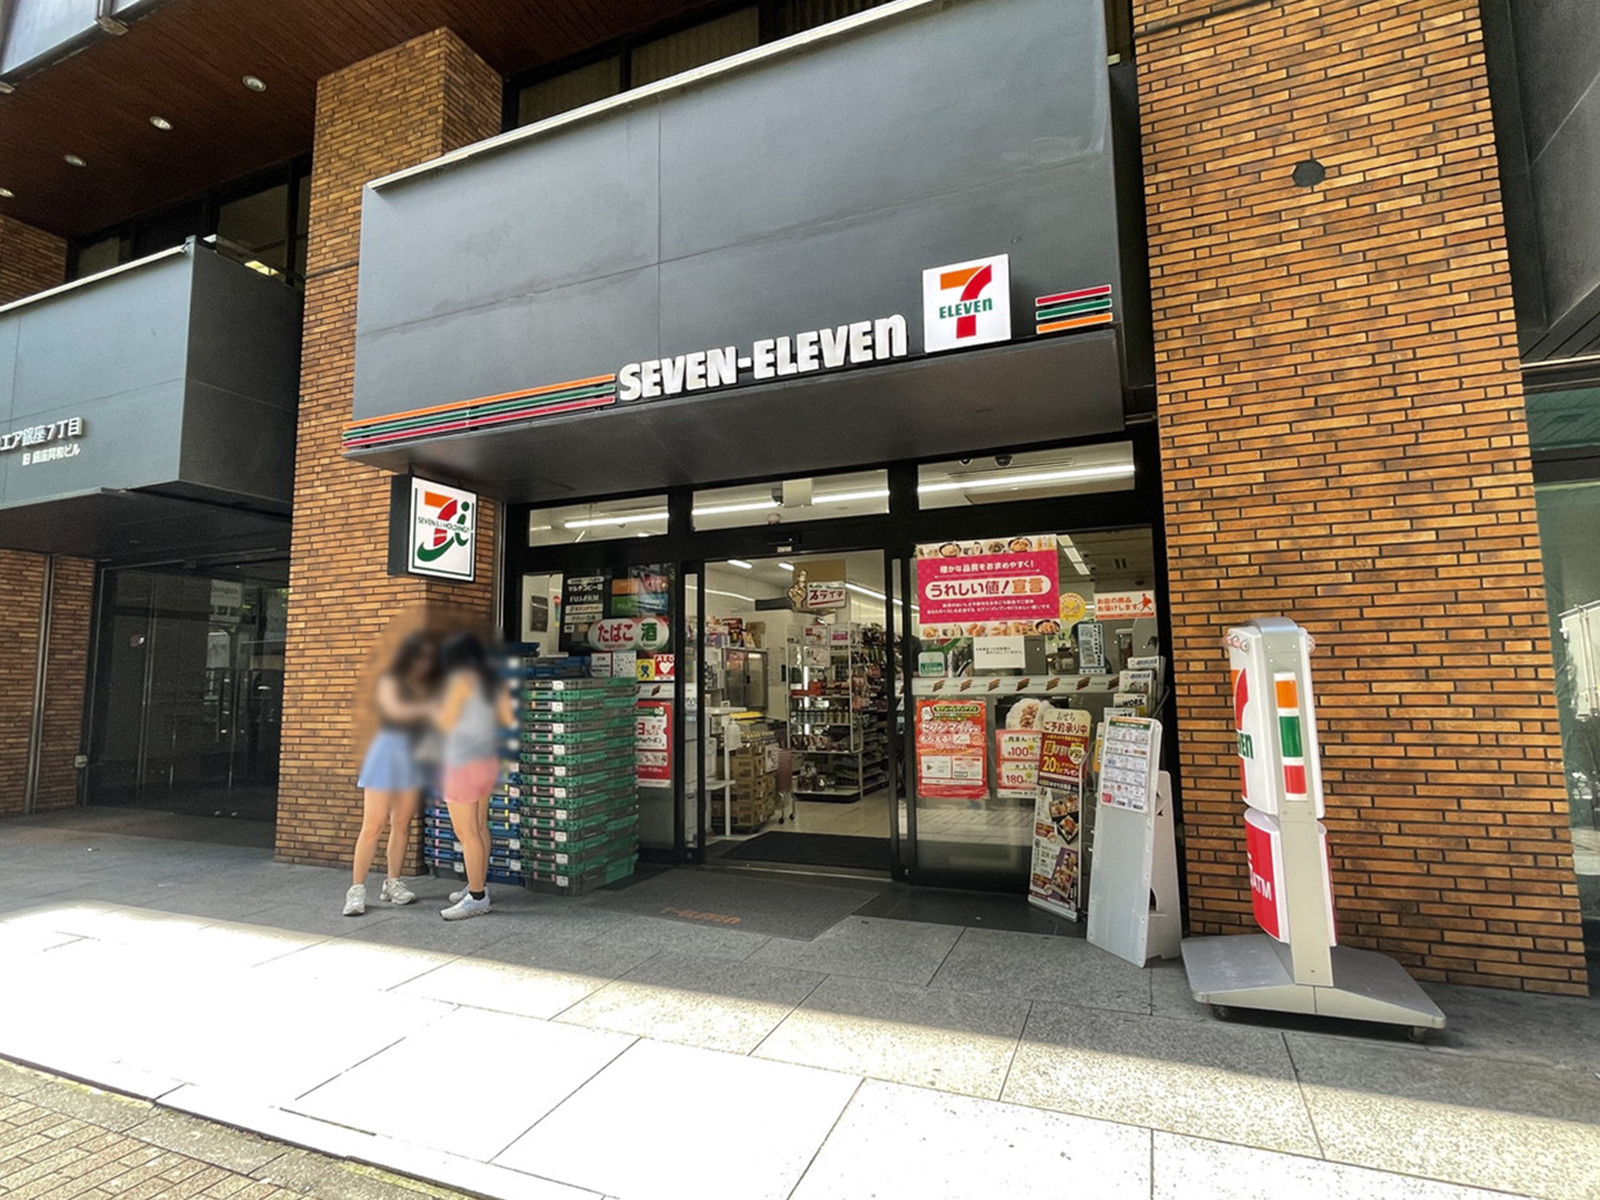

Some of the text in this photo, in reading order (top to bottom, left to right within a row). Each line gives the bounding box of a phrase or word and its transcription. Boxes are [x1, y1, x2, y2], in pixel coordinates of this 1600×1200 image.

[0, 417, 83, 451] エア銀座7丁目
[597, 622, 657, 642] たばこ 酒
